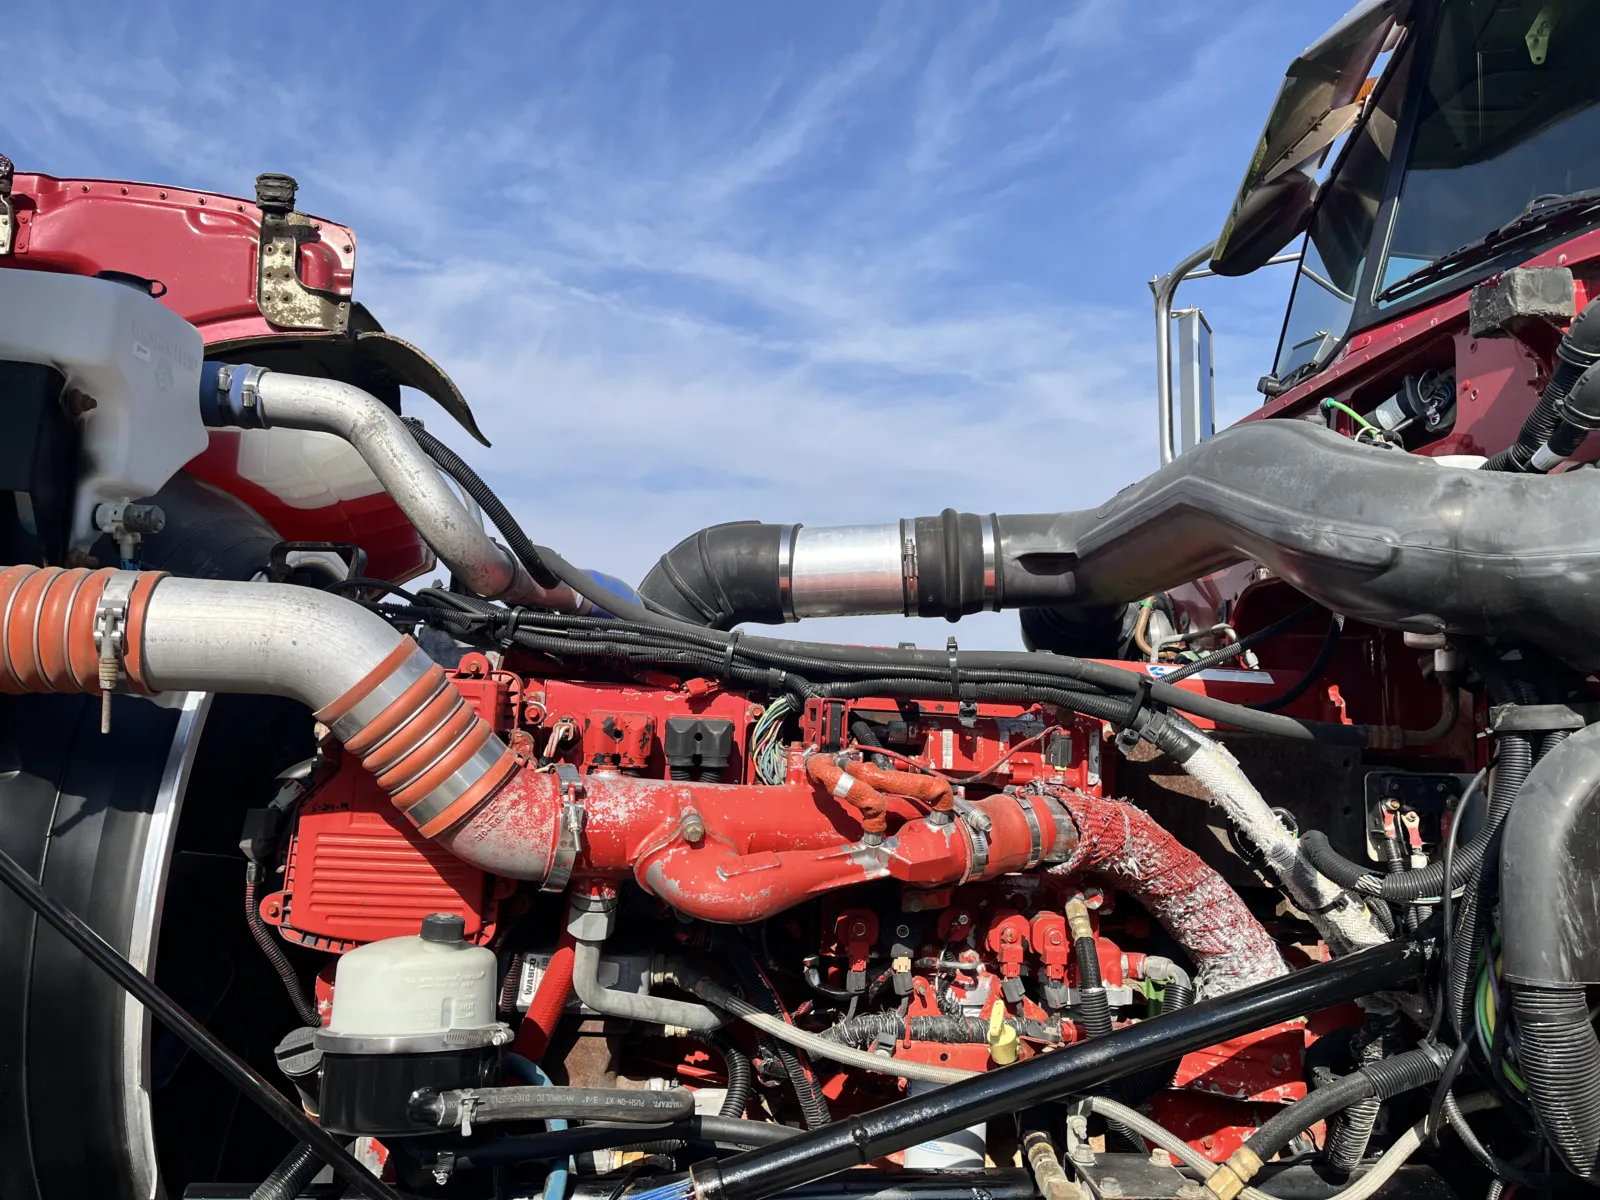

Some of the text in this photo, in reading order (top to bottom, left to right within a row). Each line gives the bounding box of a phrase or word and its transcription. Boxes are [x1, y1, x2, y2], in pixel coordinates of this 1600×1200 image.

[524, 957, 538, 995] WABCO
[605, 1096, 614, 1105] XT
[617, 1097, 645, 1107] PUSH-ON
